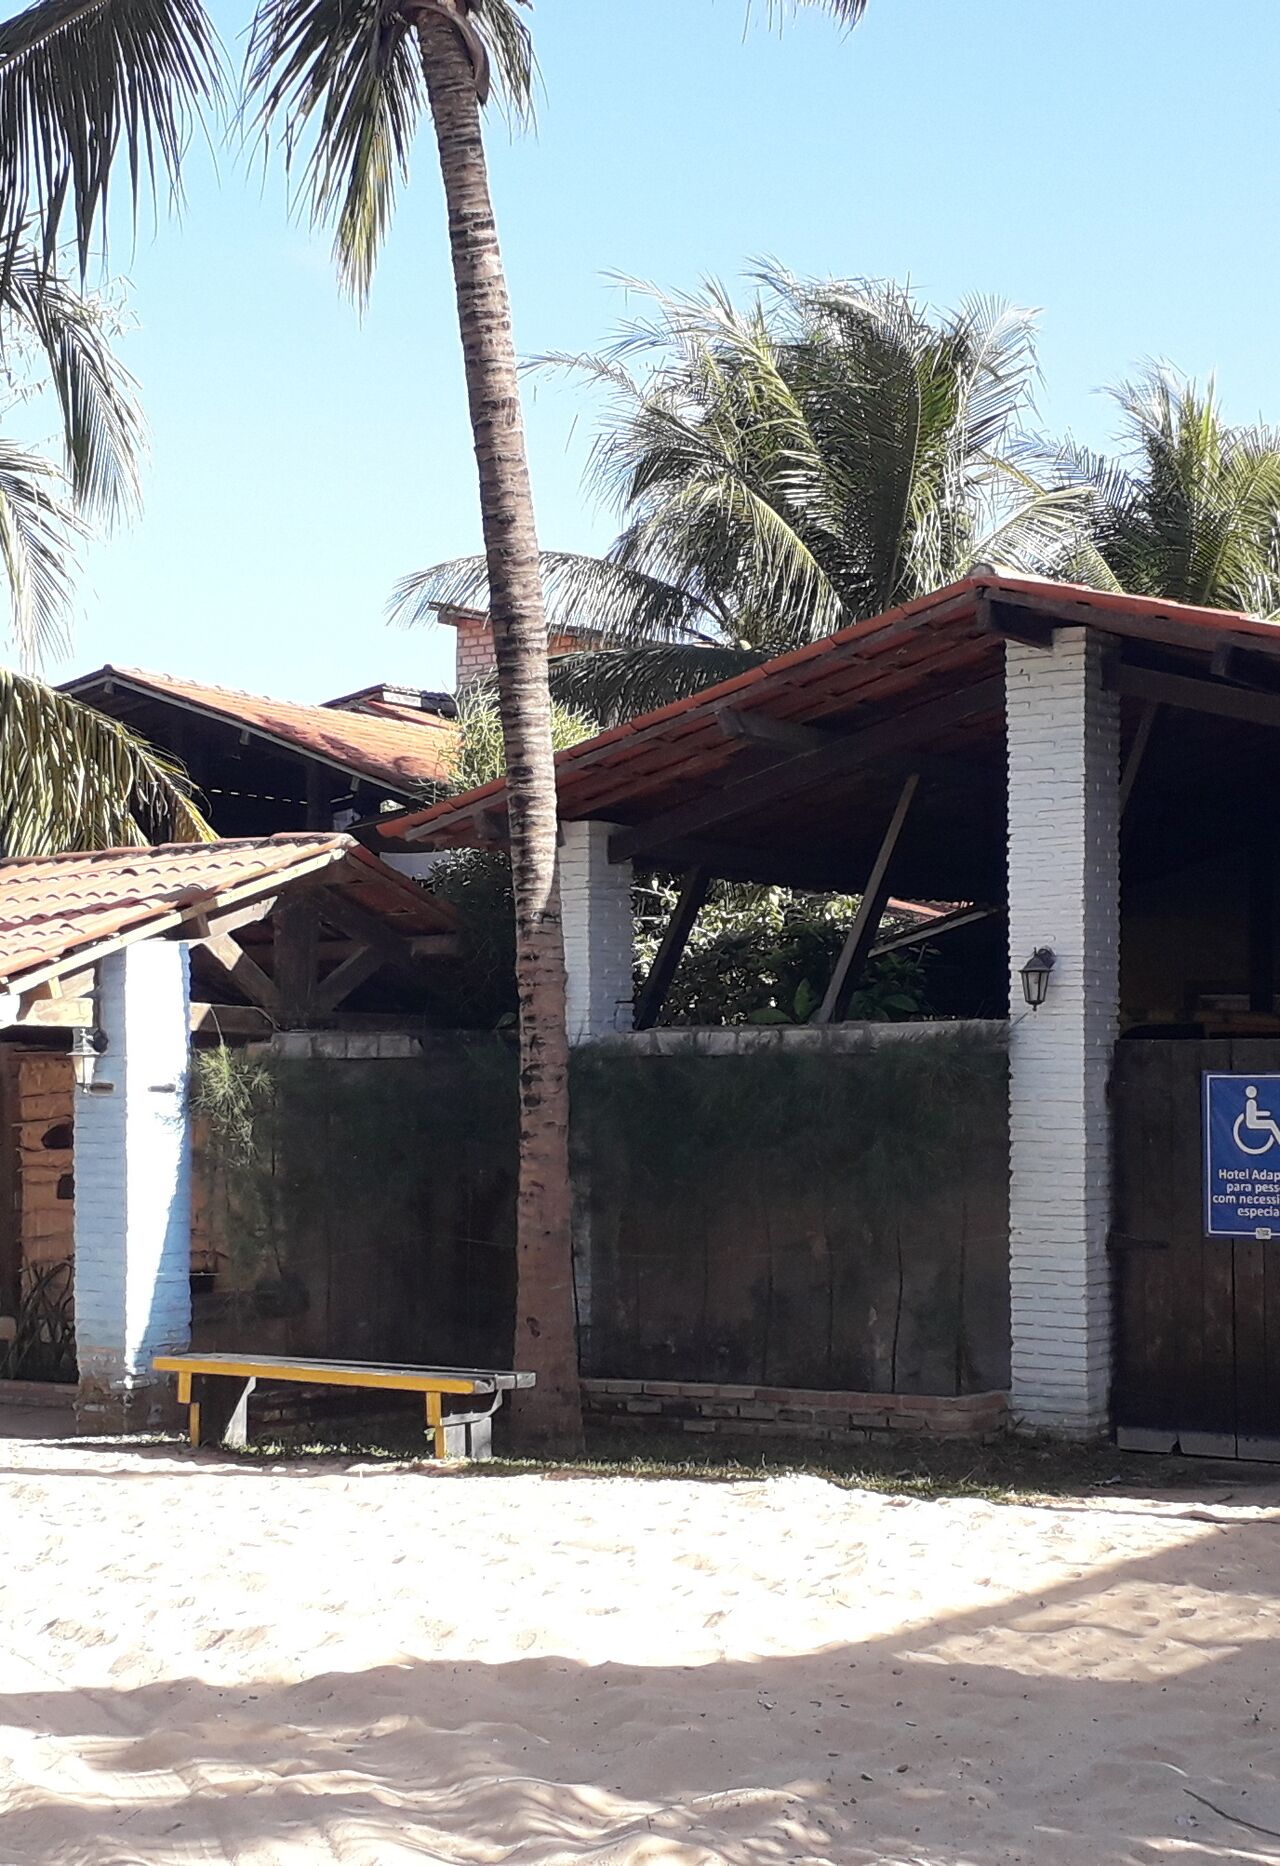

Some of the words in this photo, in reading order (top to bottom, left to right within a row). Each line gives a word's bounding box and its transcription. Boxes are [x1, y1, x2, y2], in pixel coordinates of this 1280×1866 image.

[1218, 1169, 1249, 1180] Hotel
[1226, 1183, 1252, 1194] para
[1212, 1195, 1236, 1204] com
